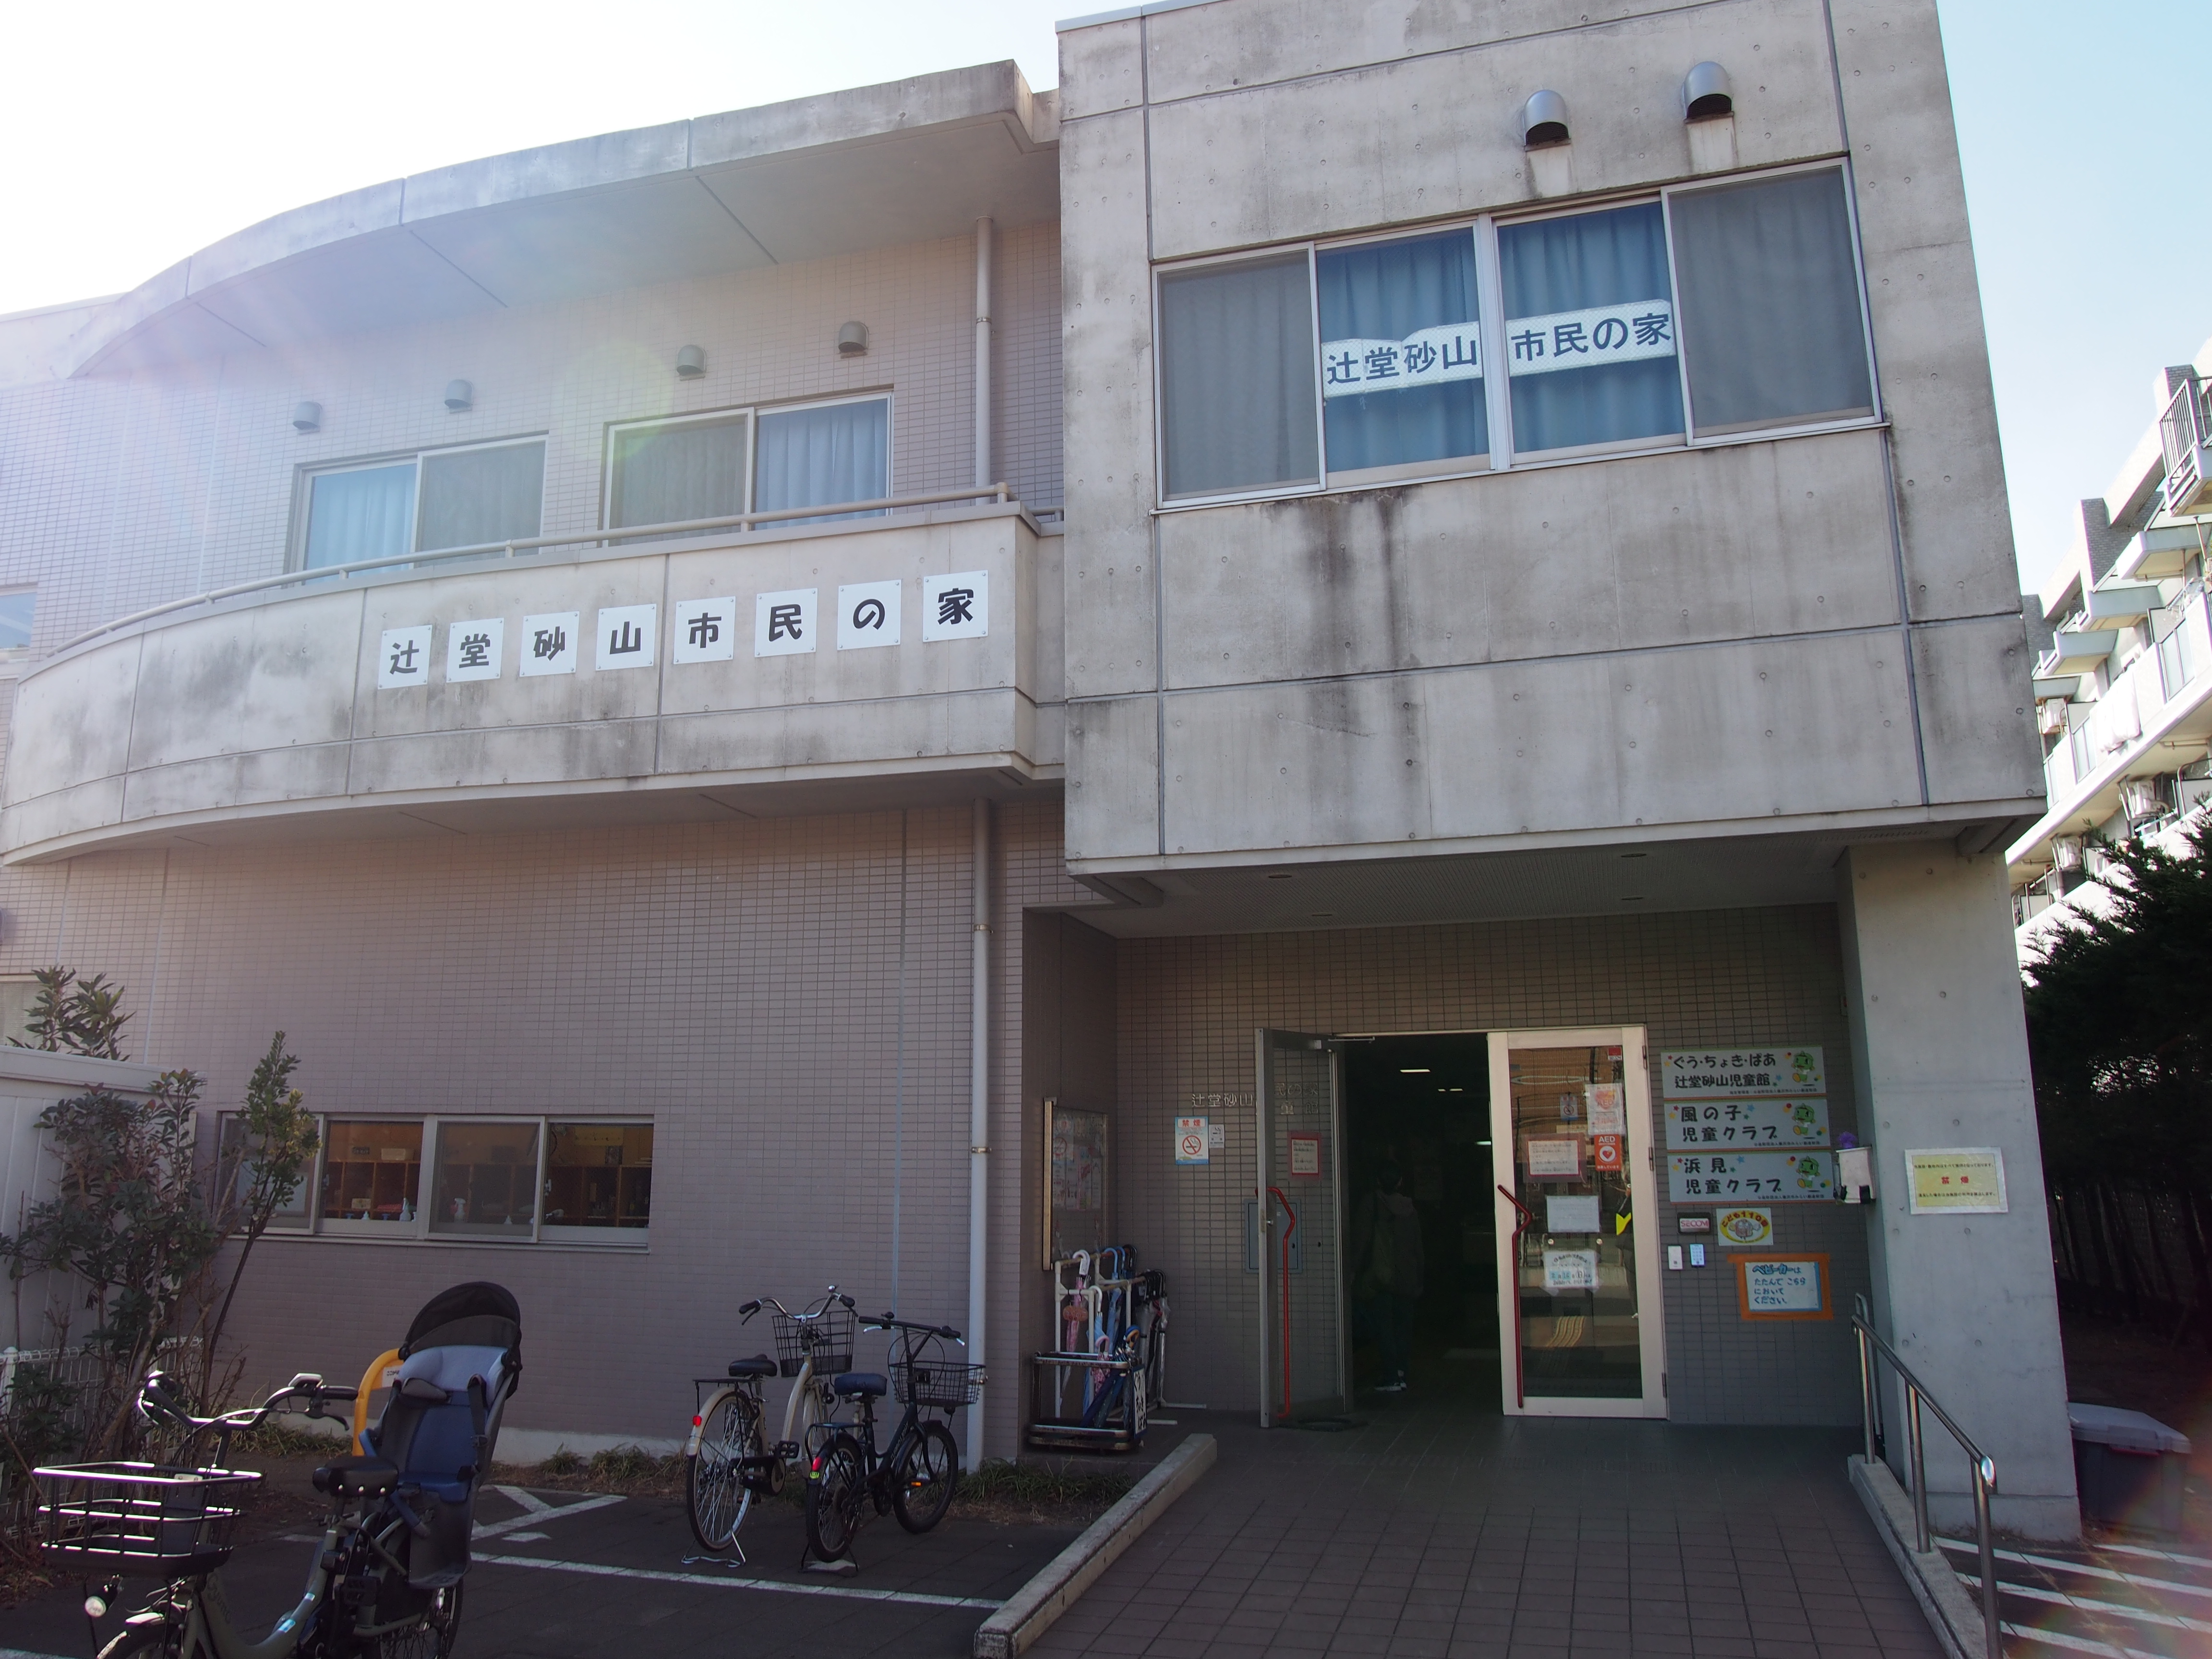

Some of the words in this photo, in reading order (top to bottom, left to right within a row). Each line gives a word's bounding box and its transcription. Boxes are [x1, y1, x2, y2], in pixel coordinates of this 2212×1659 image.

[1326, 336, 1478, 385] 辻堂砂山
[1511, 313, 1672, 362] 市民の家
[389, 587, 974, 675] 辻堂砂山市民の家
[1674, 1073, 1771, 1089] 辻堂砂山児童館
[1191, 1093, 1253, 1108] 辻堂砂山
[1681, 1105, 1742, 1122] 風の子
[1182, 1118, 1201, 1127] 禁煙
[1682, 1126, 1778, 1142] 児童クラブ
[1684, 1157, 1726, 1174] 浜見
[1686, 1178, 1782, 1194] 児童クラブ
[1752, 1263, 1802, 1274] ベビーカーは
